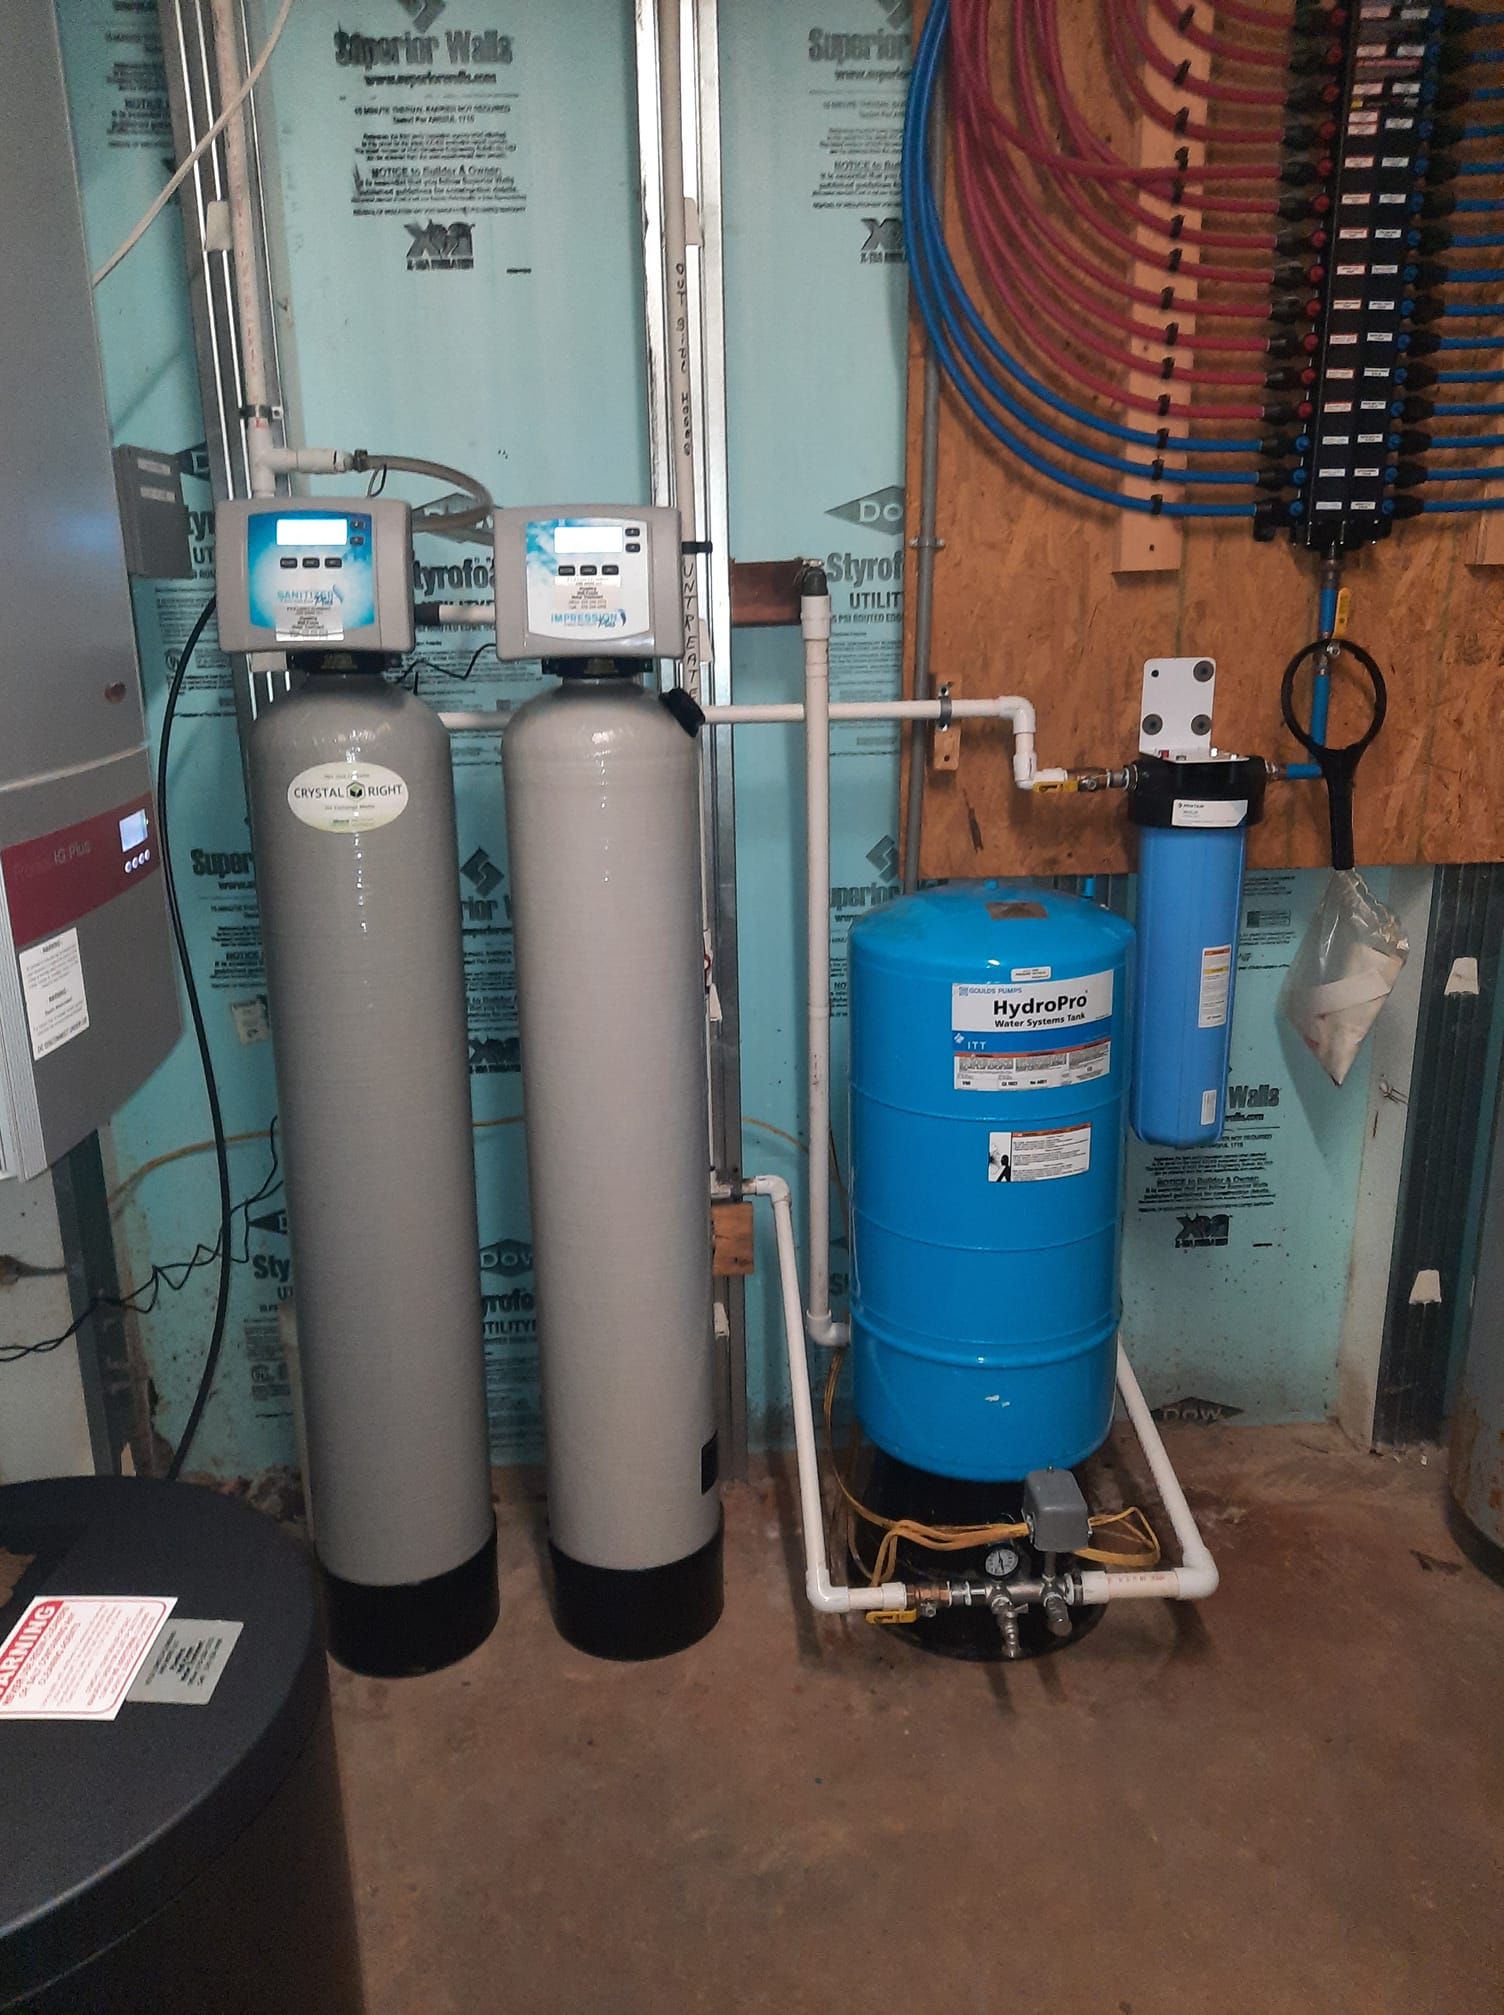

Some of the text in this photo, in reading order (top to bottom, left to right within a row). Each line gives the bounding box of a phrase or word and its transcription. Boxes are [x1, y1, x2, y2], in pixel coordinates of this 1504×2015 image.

[858, 502, 904, 522] DO
[294, 784, 402, 798] CRYSTAL RIGHT
[969, 987, 997, 995] GOULDS
[993, 995, 1087, 1019] HydroPro
[994, 1012, 1086, 1029] Water Systems Tank
[967, 1041, 987, 1050] ITT
[1228, 1084, 1280, 1109] Walls
